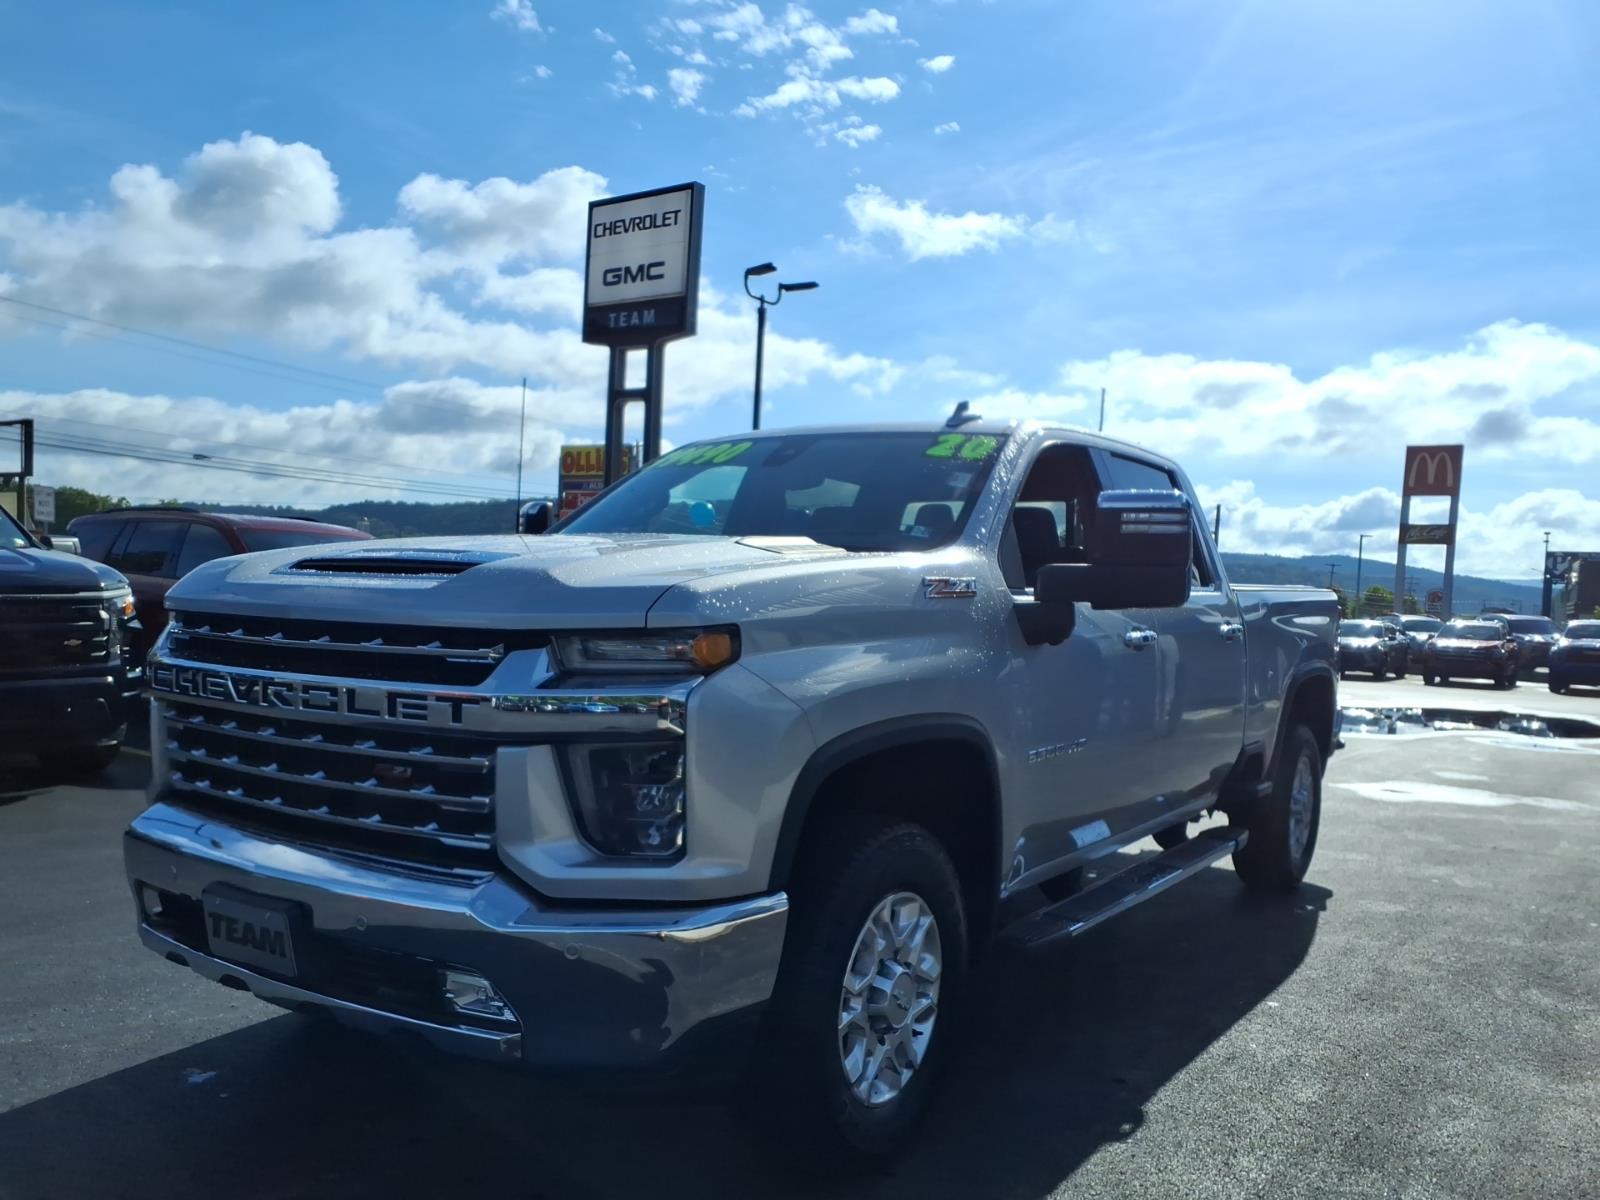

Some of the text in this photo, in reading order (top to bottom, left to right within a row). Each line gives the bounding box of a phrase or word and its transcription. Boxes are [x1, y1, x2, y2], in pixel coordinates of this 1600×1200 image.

[593, 209, 681, 238] CHEVROLET
[603, 261, 665, 286] GMC
[608, 310, 655, 328] TEAM
[150, 663, 482, 726] CHEVROLET
[207, 911, 288, 959] TEAM
